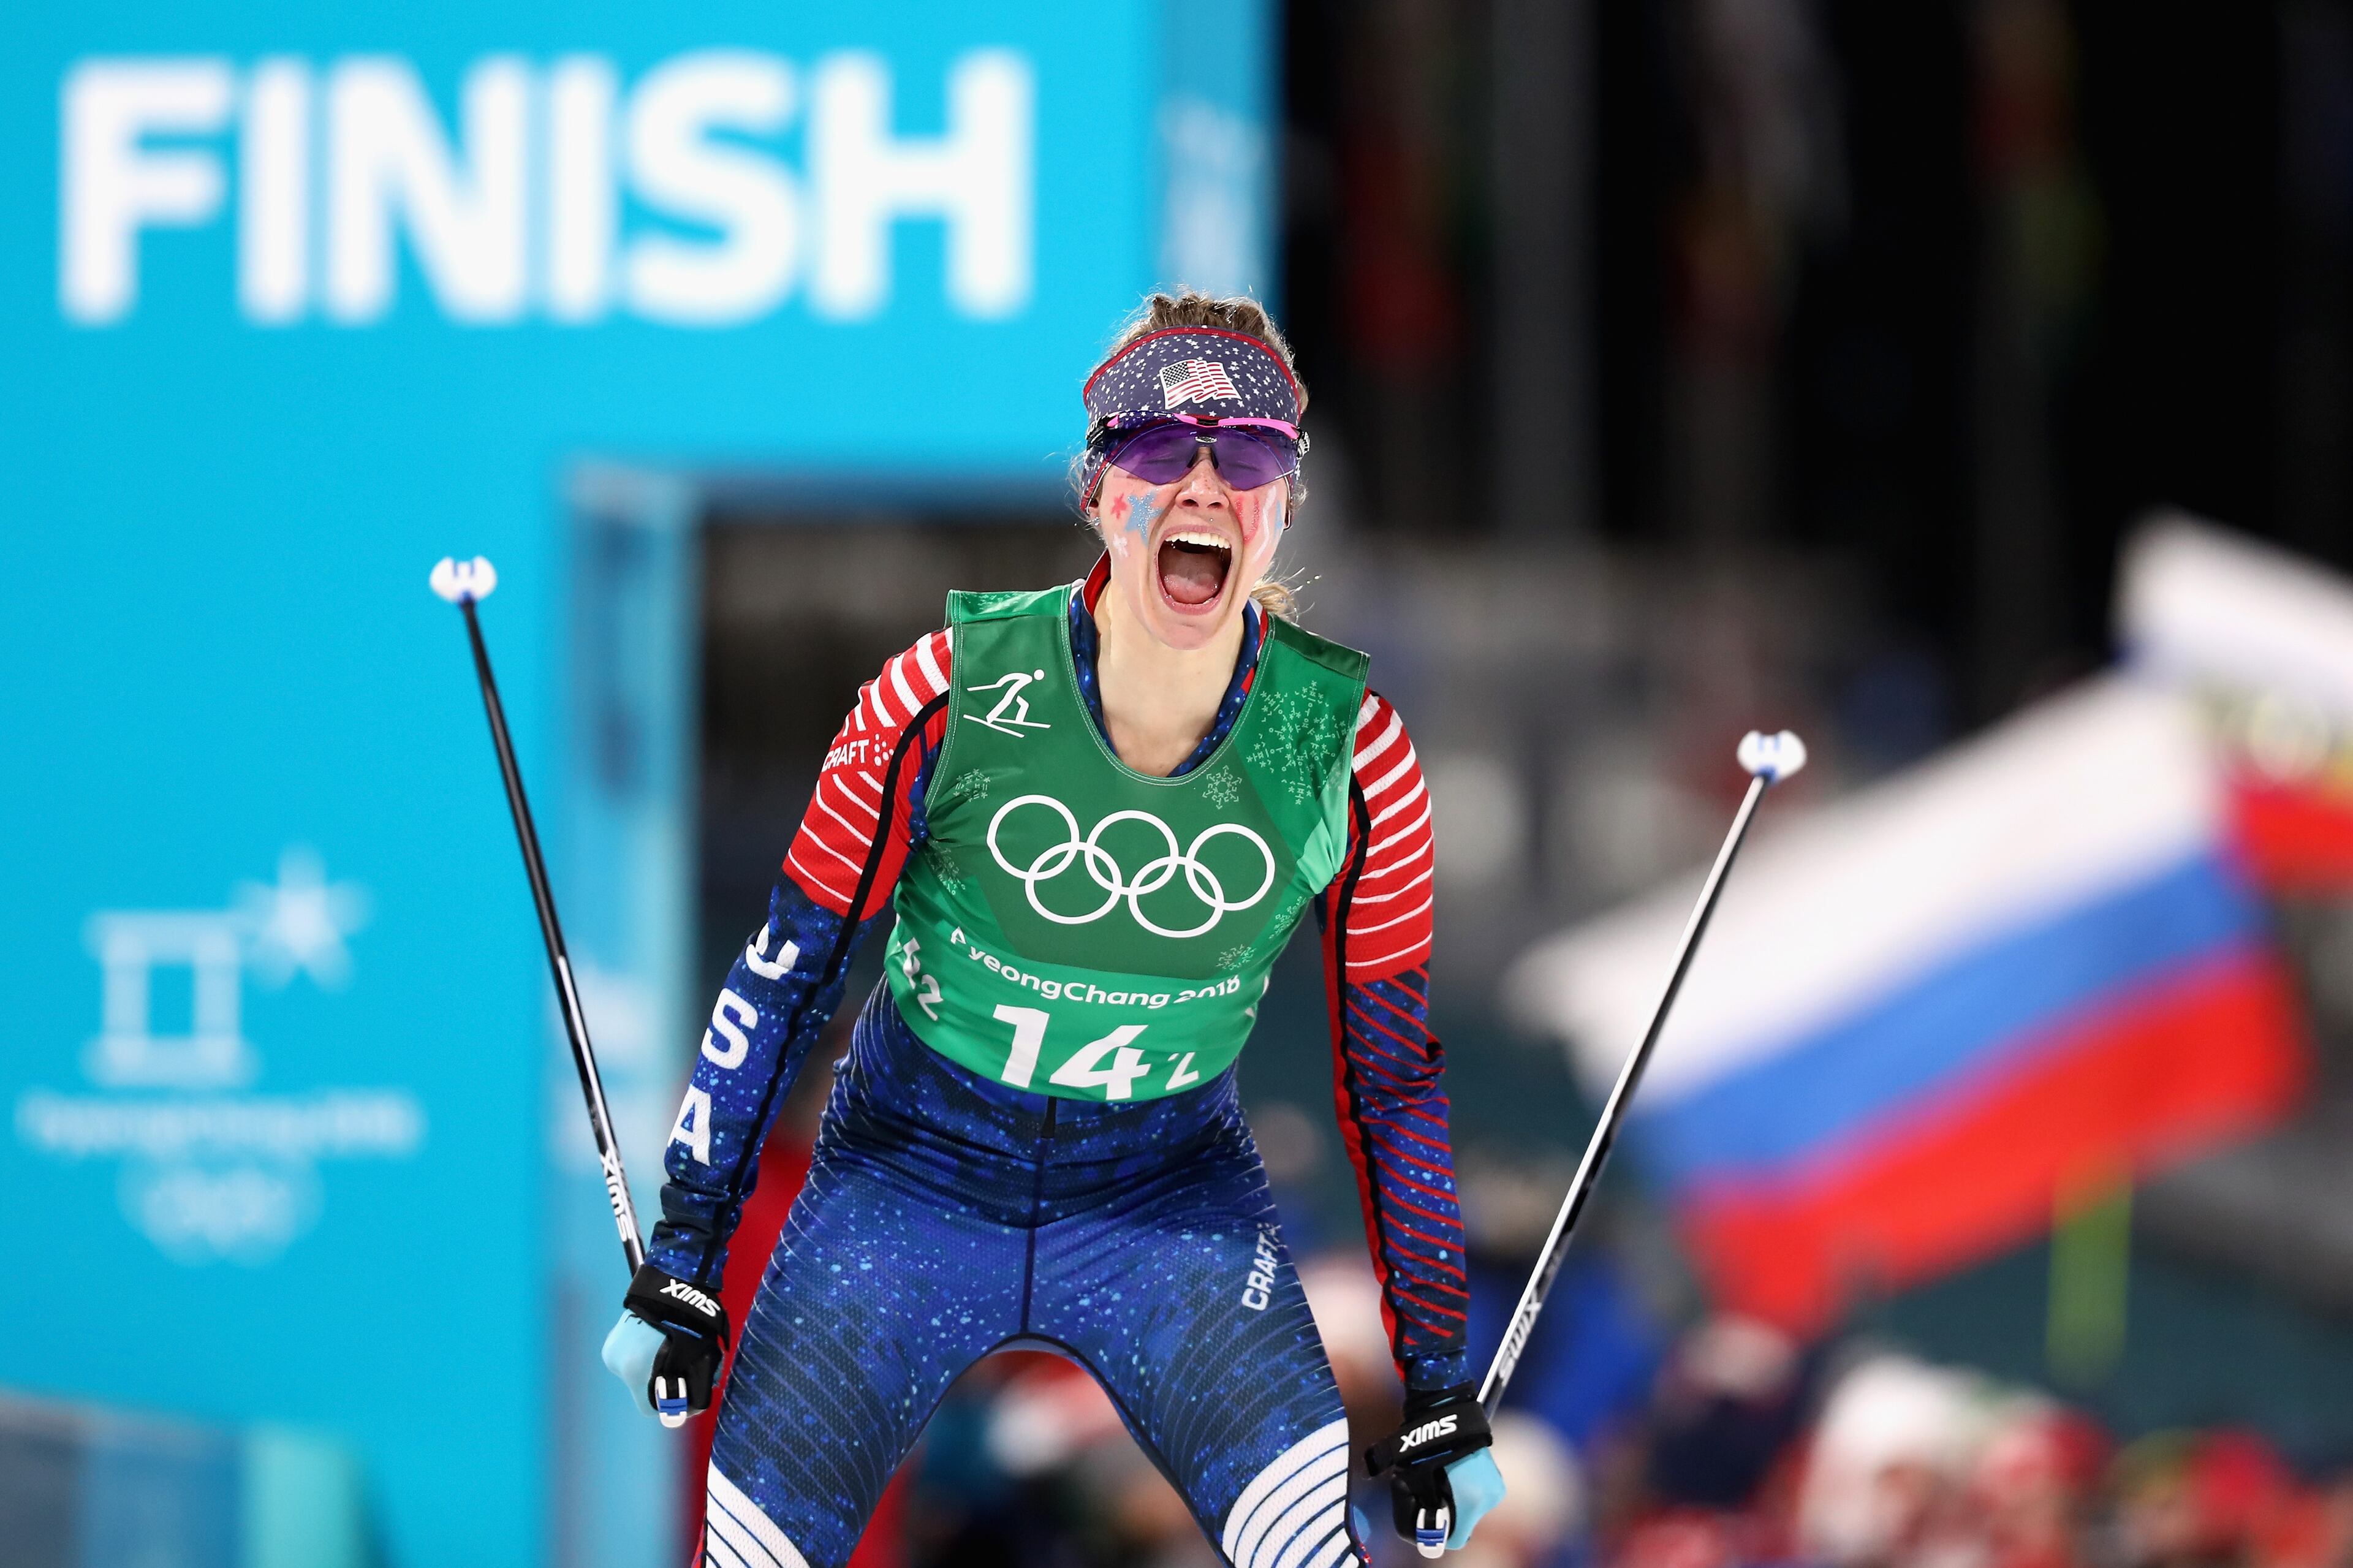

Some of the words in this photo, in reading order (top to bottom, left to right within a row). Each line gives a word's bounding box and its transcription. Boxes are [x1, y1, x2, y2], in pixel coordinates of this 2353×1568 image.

[61, 51, 1033, 324] FINISH
[821, 738, 870, 773] CRAFT
[667, 922, 800, 1167] USA
[992, 1003, 1152, 1100] 14
[659, 1278, 721, 1317] SWIX
[1241, 1230, 1279, 1311] CRAFT
[1399, 1414, 1458, 1453] SWIX
